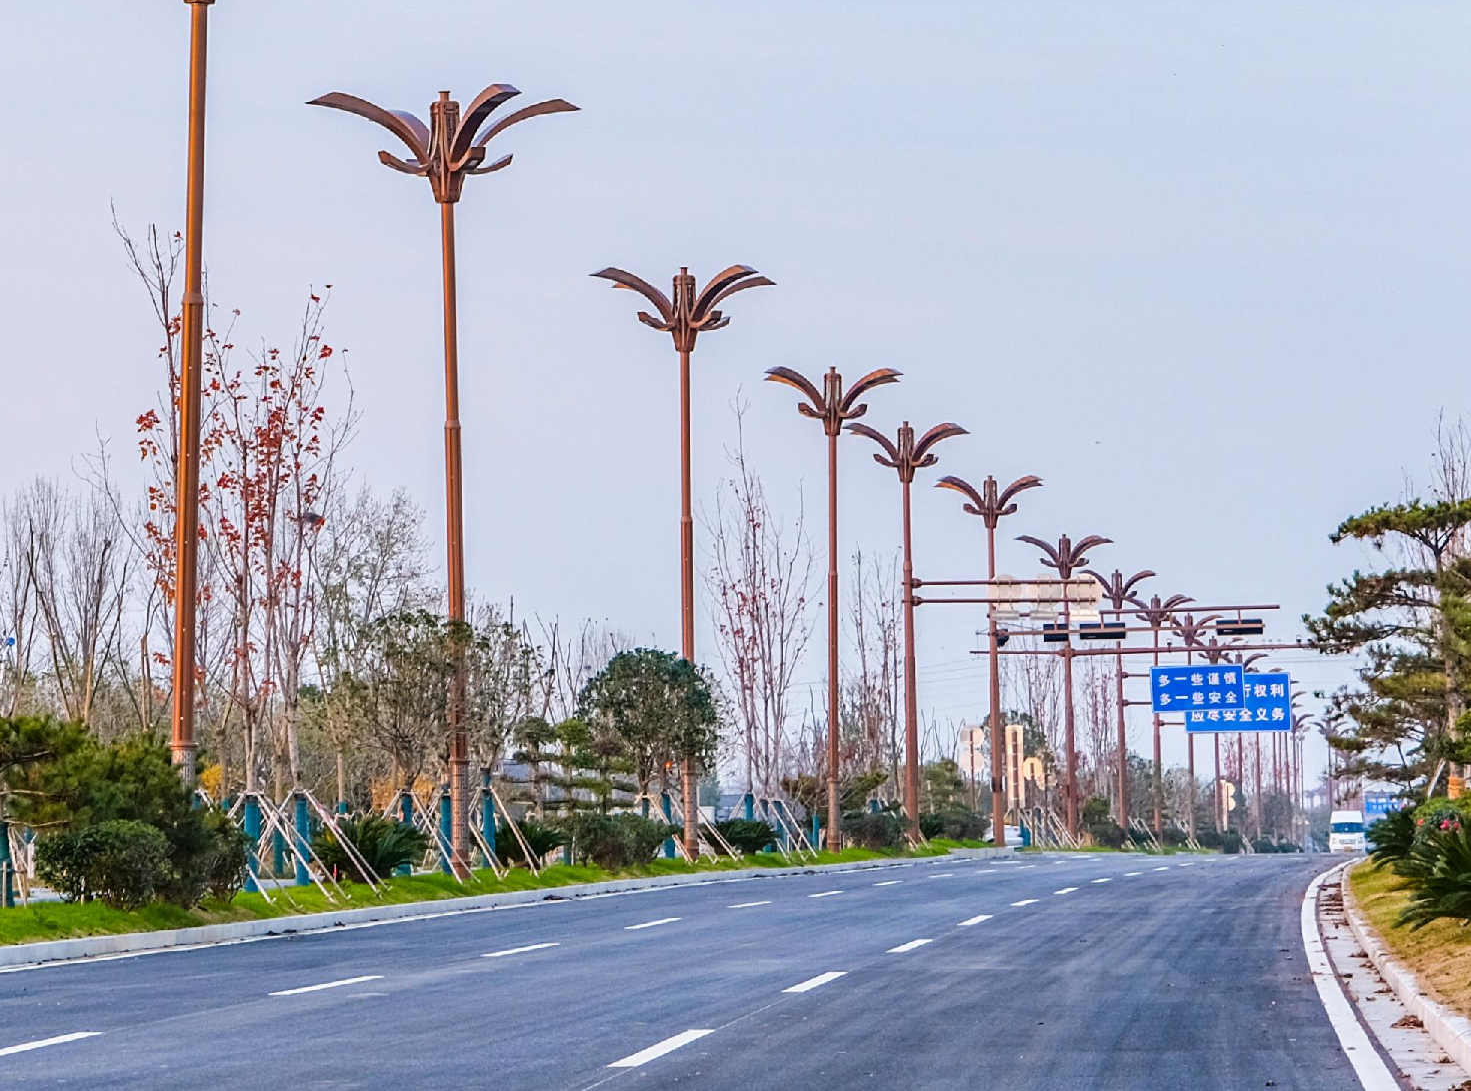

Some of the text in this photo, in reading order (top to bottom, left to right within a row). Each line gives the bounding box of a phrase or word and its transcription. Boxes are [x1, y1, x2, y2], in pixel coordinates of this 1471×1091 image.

[1158, 672, 1237, 687] 多一些谨慎
[1159, 691, 1237, 706] 多一些安全
[1191, 708, 1285, 721] 应尽安全义务
